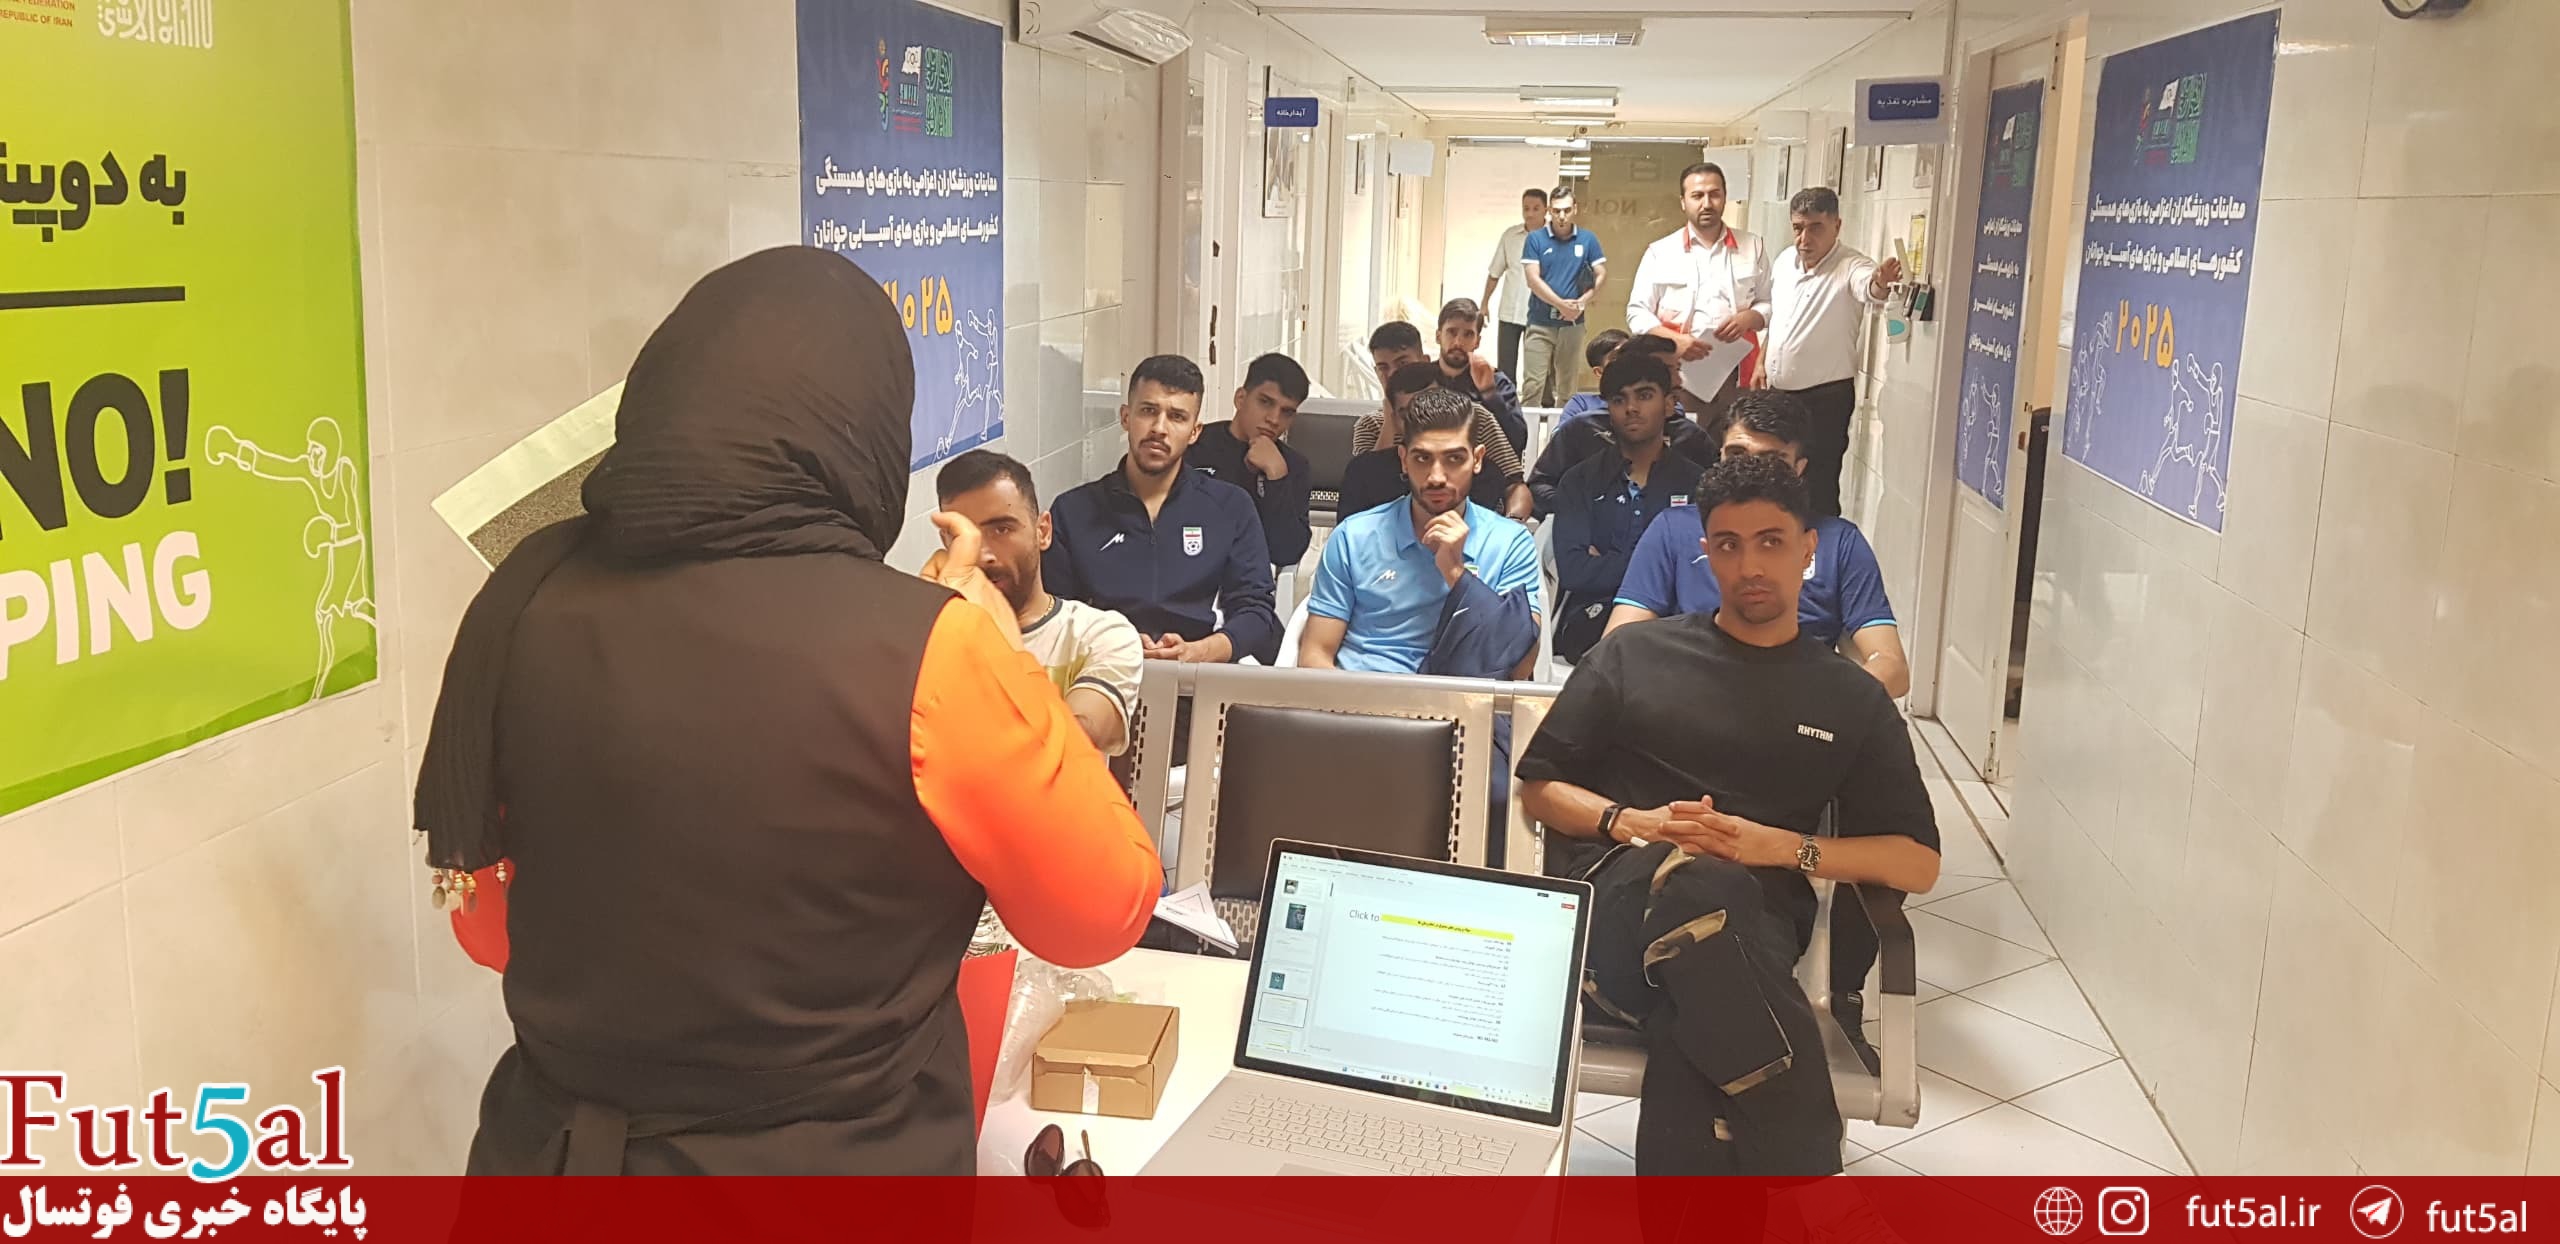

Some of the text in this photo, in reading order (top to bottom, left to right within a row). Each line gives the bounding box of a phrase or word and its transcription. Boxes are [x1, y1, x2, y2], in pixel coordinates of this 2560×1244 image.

[40, 15, 52, 24] OF
[815, 155, 865, 196] همبستگی
[902, 170, 912, 196] به
[912, 168, 937, 198] اعزامی
[937, 167, 974, 198] ورزشکاران
[0, 141, 187, 243] به دوپین
[2170, 192, 2210, 227] ورزشکاران
[2211, 195, 2246, 226] معاینات
[813, 218, 848, 252] جوانان
[935, 216, 960, 245] اسلامی
[2162, 246, 2191, 274] اسلامی
[2115, 299, 2175, 369] ۲۰۲۵
[0, 368, 191, 540] NO!
[1797, 724, 1834, 742] RHYTHM
[1349, 909, 1380, 923] Click to
